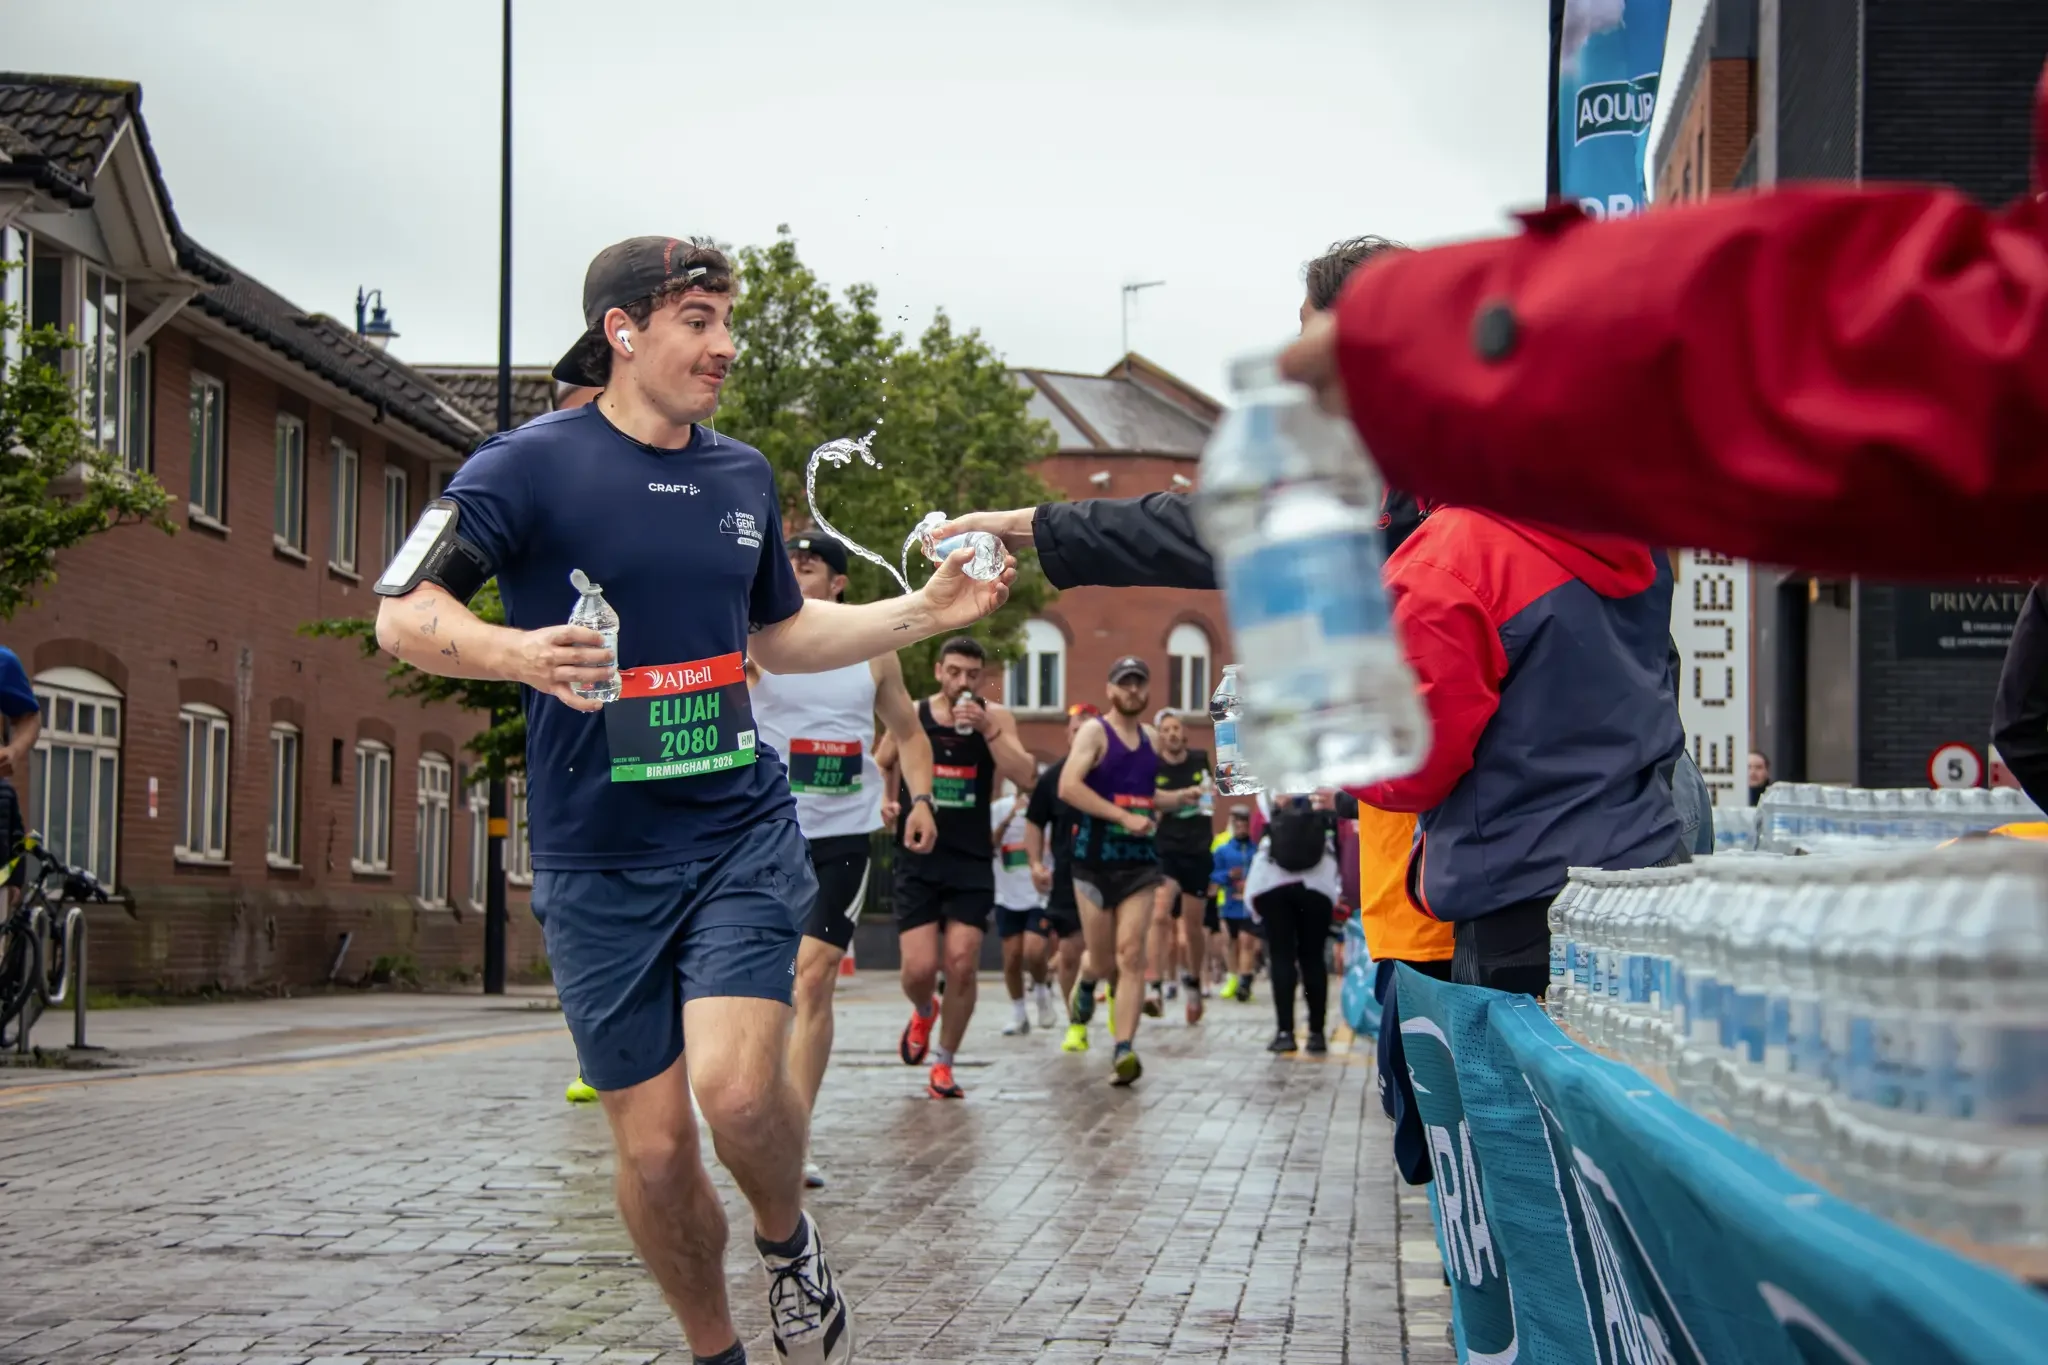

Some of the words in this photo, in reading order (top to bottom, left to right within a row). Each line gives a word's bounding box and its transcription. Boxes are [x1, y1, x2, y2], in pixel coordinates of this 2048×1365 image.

[648, 482, 688, 494] CRAFT
[736, 518, 756, 530] GENT
[650, 692, 720, 727] ELIJAH
[660, 725, 719, 758] 2080
[741, 733, 753, 746] HM
[646, 758, 711, 778] BIRMINGHAM
[713, 755, 734, 769] 2026
[1946, 759, 1964, 782] 5
